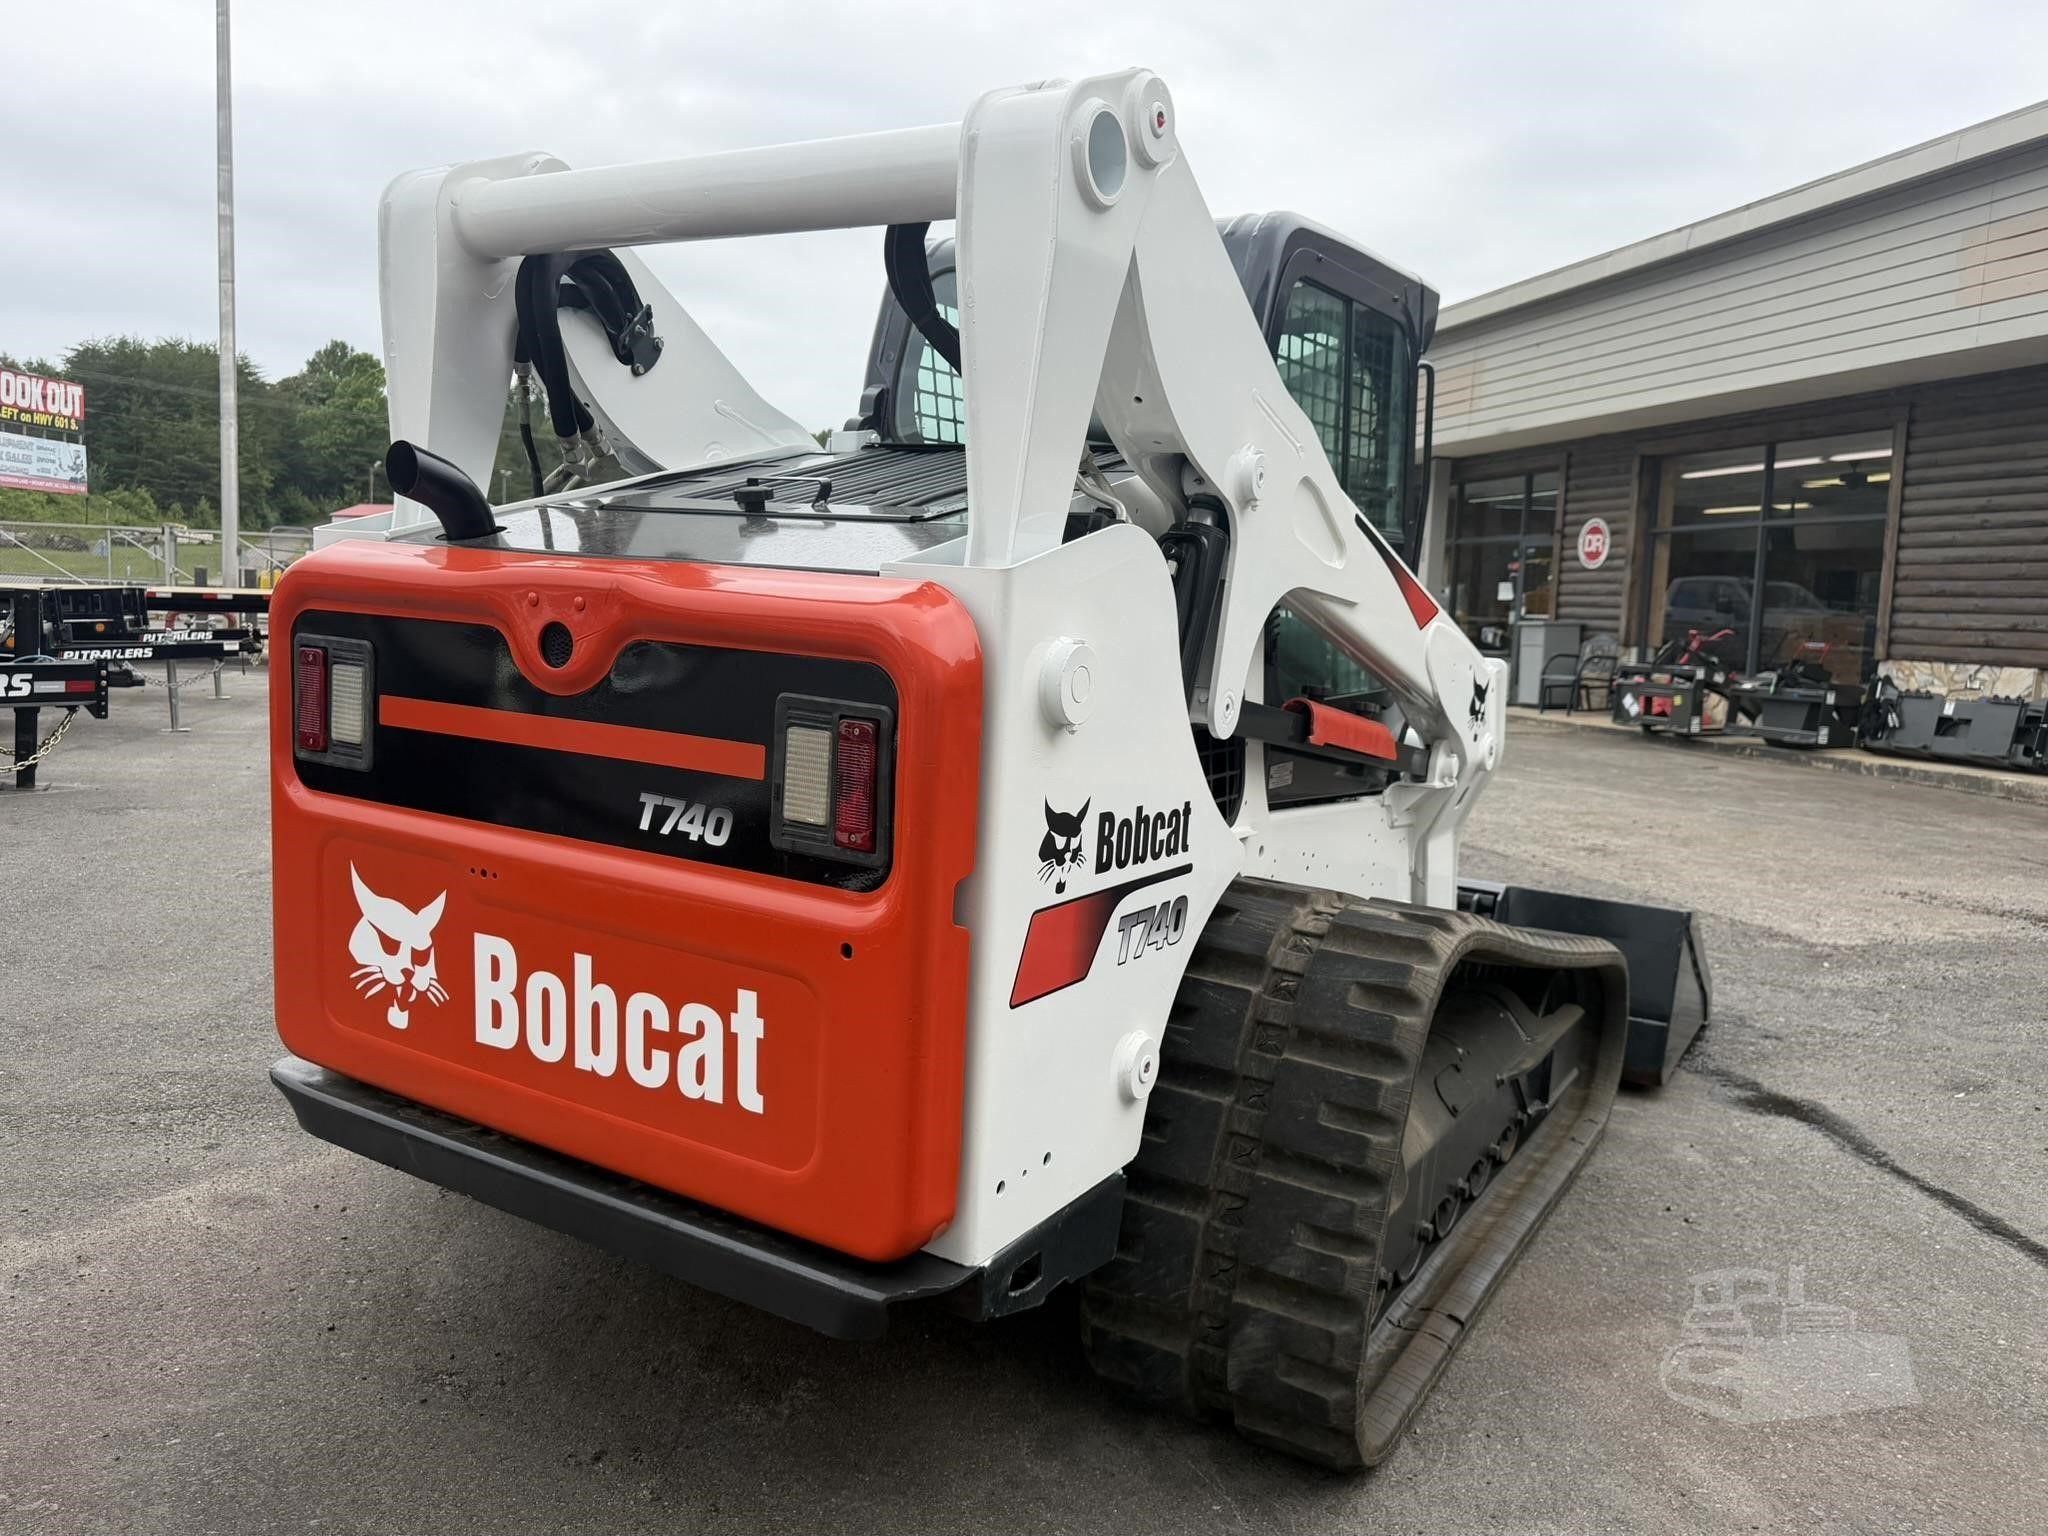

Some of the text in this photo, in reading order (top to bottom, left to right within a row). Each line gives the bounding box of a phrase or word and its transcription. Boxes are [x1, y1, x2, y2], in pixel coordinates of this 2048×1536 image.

[20, 413, 31, 423] on
[33, 413, 53, 427] HWY
[54, 416, 69, 431] 601
[46, 381, 82, 417] OUT
[639, 792, 734, 847] T740
[1095, 801, 1191, 875] Bobcat
[1117, 895, 1189, 966] T740
[472, 932, 764, 1115] Bobcat
